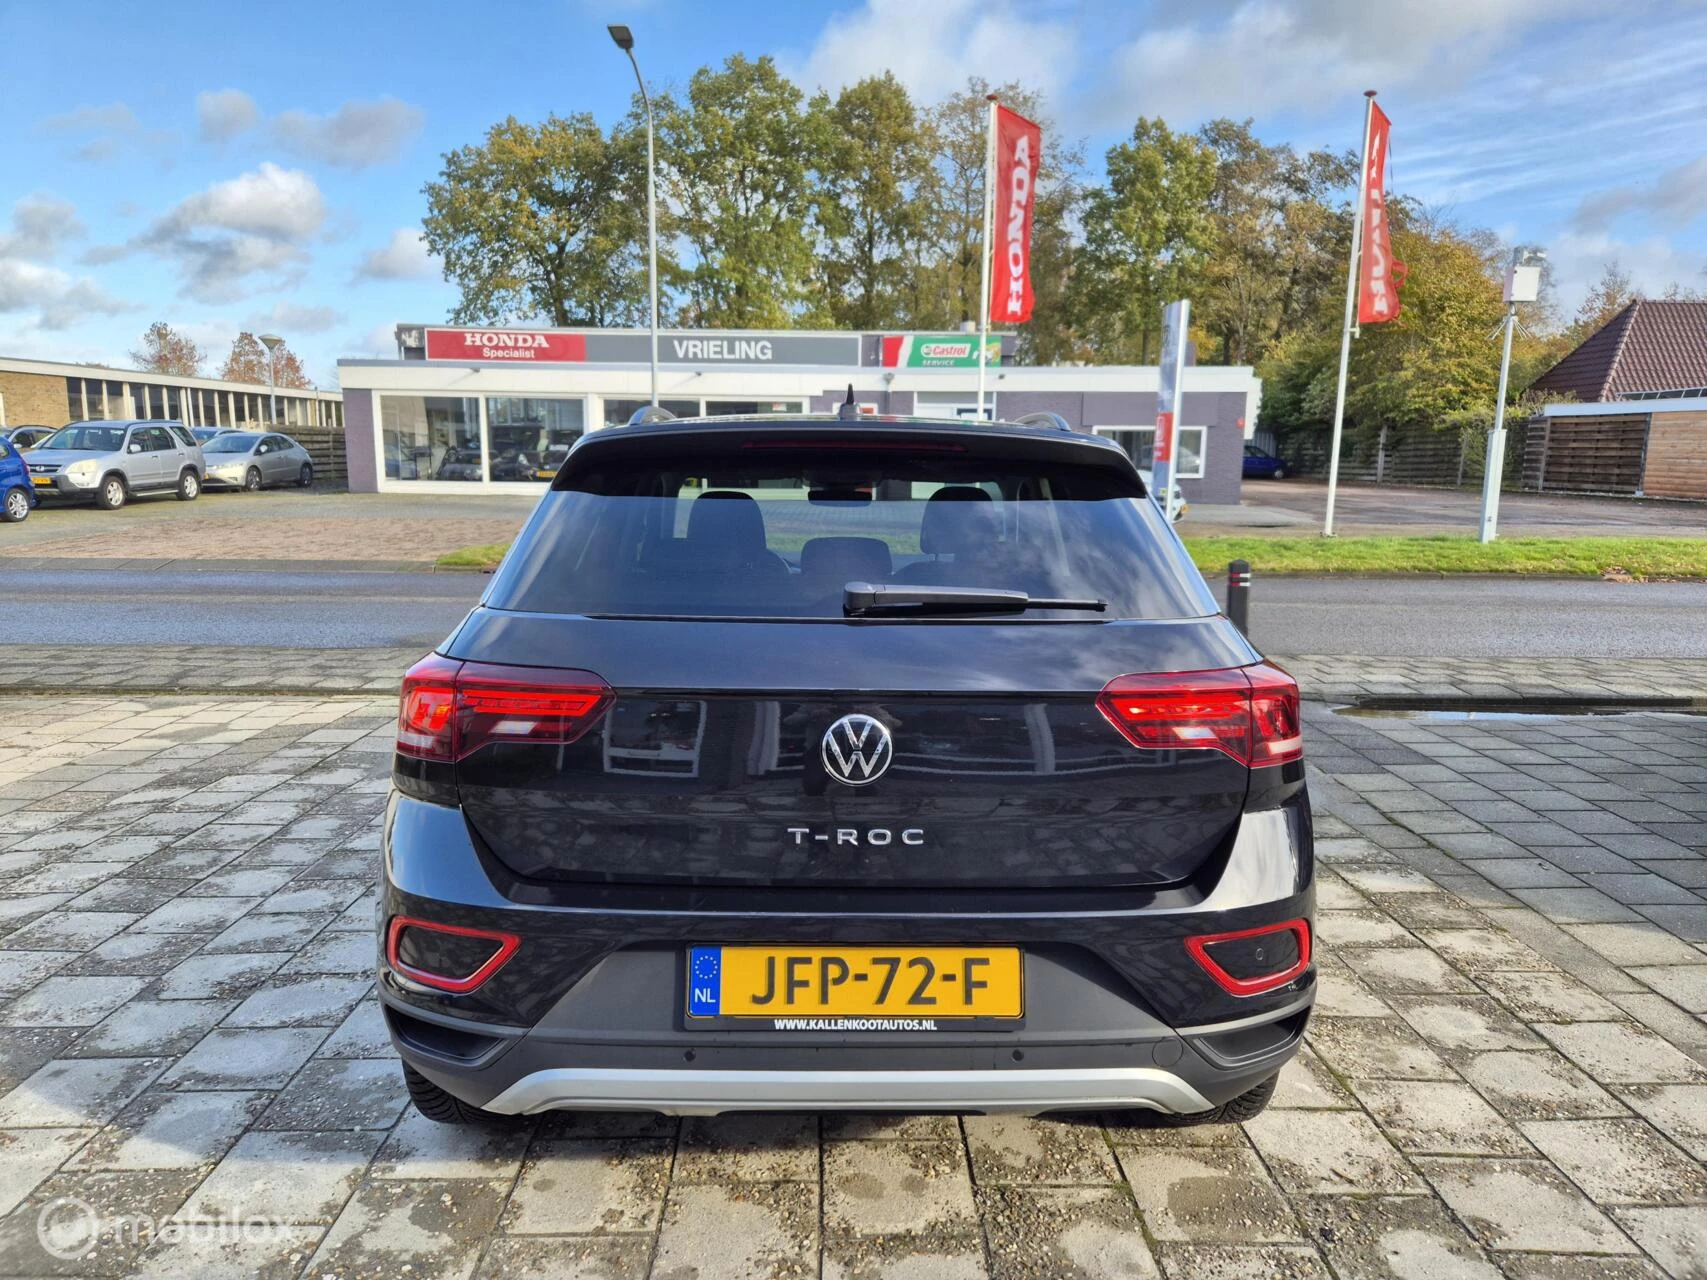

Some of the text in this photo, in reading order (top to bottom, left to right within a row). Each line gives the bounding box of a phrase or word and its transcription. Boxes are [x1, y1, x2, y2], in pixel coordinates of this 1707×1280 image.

[1007, 135, 1031, 317] HONDA
[464, 333, 549, 348] HONDA
[482, 347, 535, 359] Specialist
[673, 339, 773, 361] VRIELING
[932, 345, 967, 356] Castrol
[786, 827, 925, 846] T-ROC
[750, 954, 992, 1006] JFP-72-F
[694, 988, 717, 1004] NL
[773, 1018, 938, 1032] WWW.KALLENKOOTAUTOS.NL
